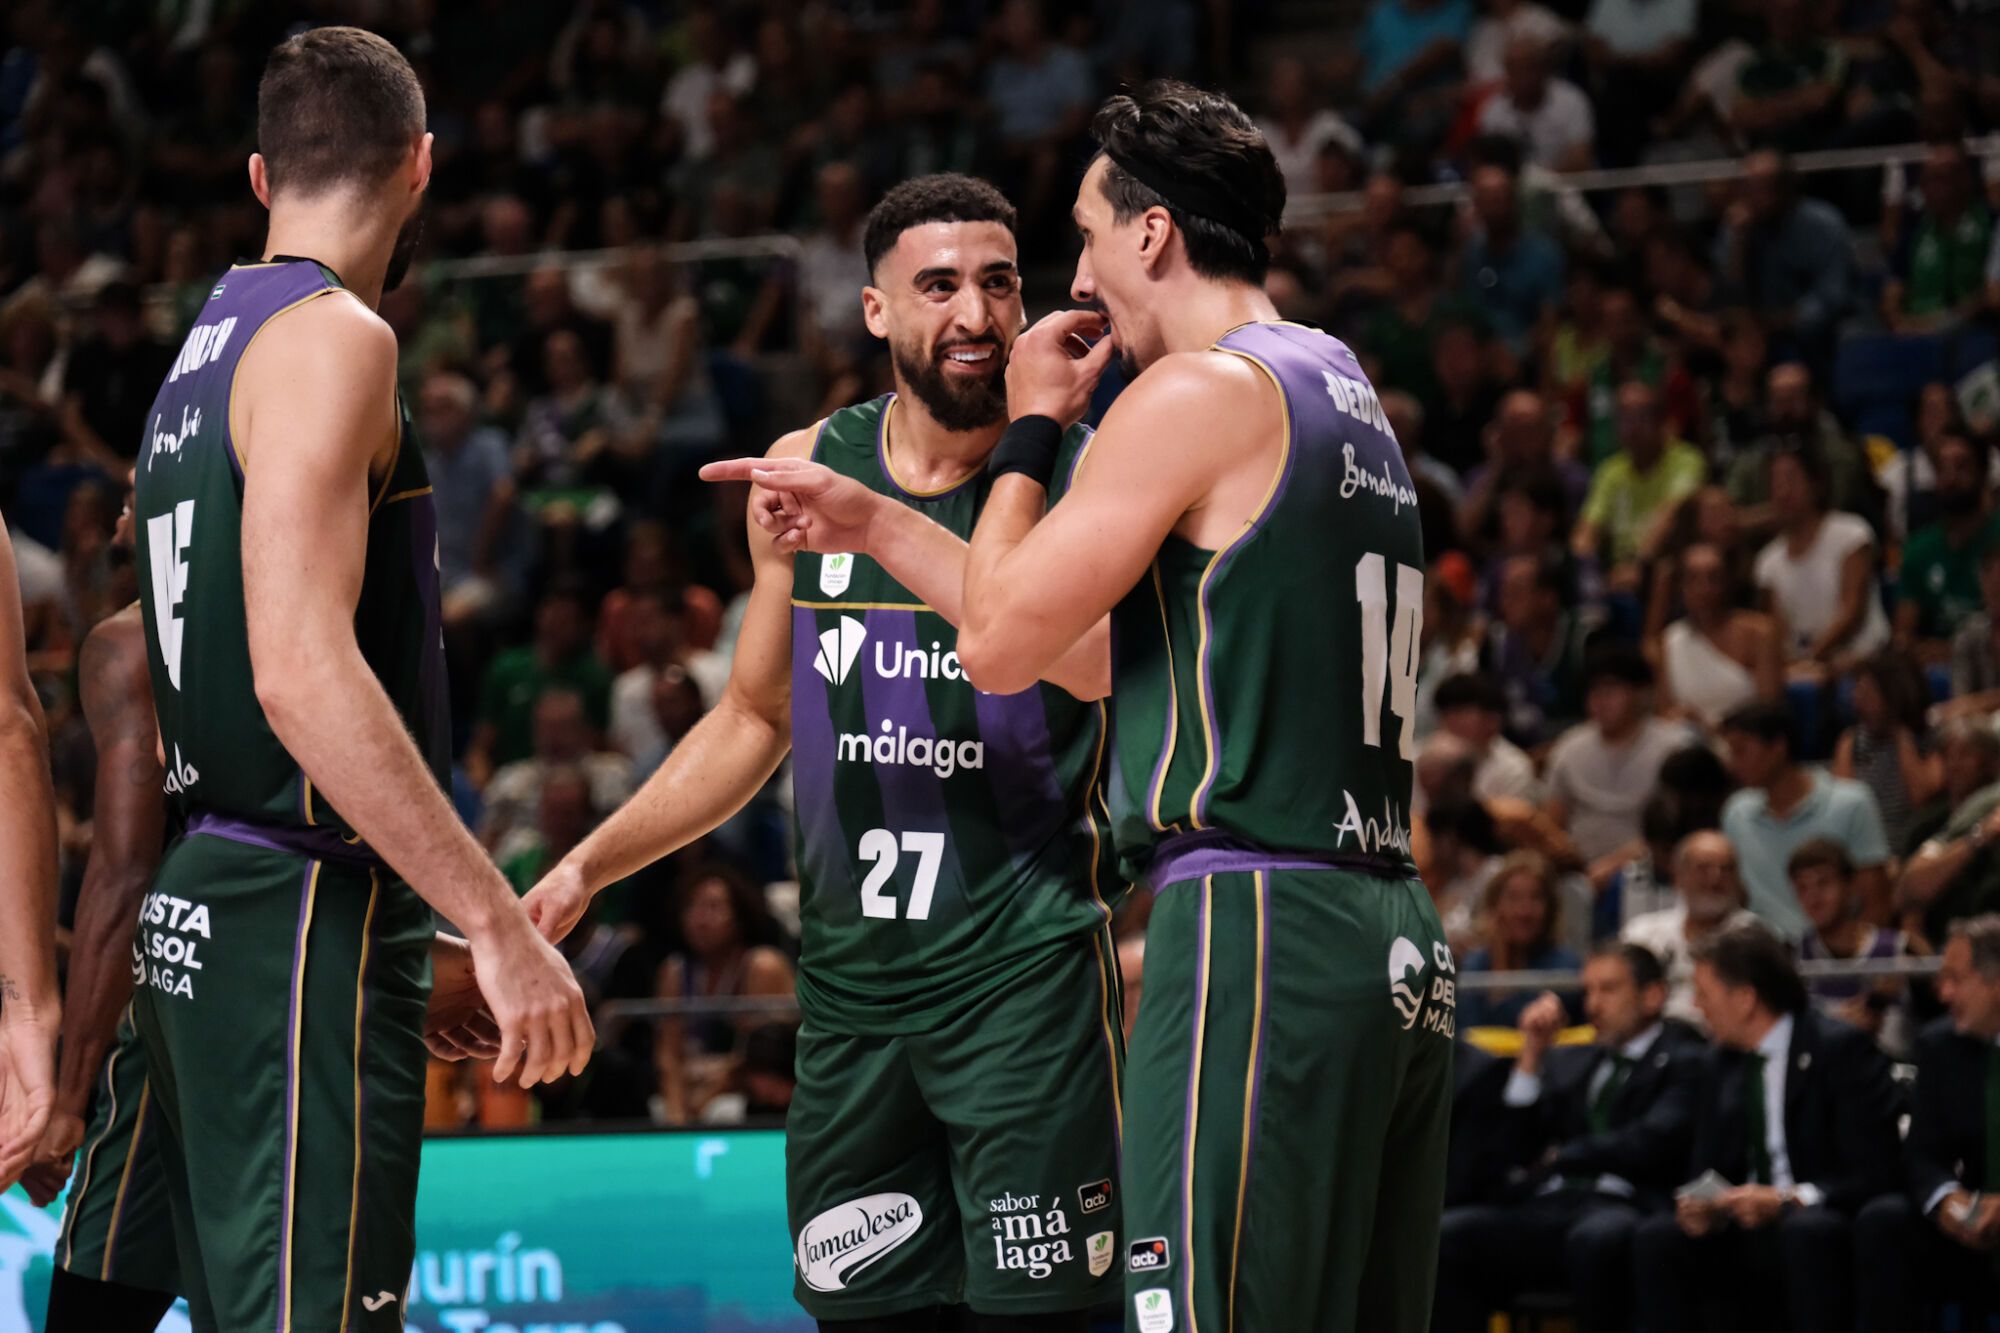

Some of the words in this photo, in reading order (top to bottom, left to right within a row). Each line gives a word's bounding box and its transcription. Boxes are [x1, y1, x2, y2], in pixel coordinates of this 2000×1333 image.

[1355, 552, 1425, 763] 14
[857, 828, 945, 920] 27
[151, 932, 203, 970] SOL
[990, 1191, 1040, 1212] sabor
[1084, 1192, 1106, 1209] acb
[803, 1198, 915, 1277] famadesa
[993, 1234, 1075, 1279] laga
[1131, 1250, 1159, 1268] acb
